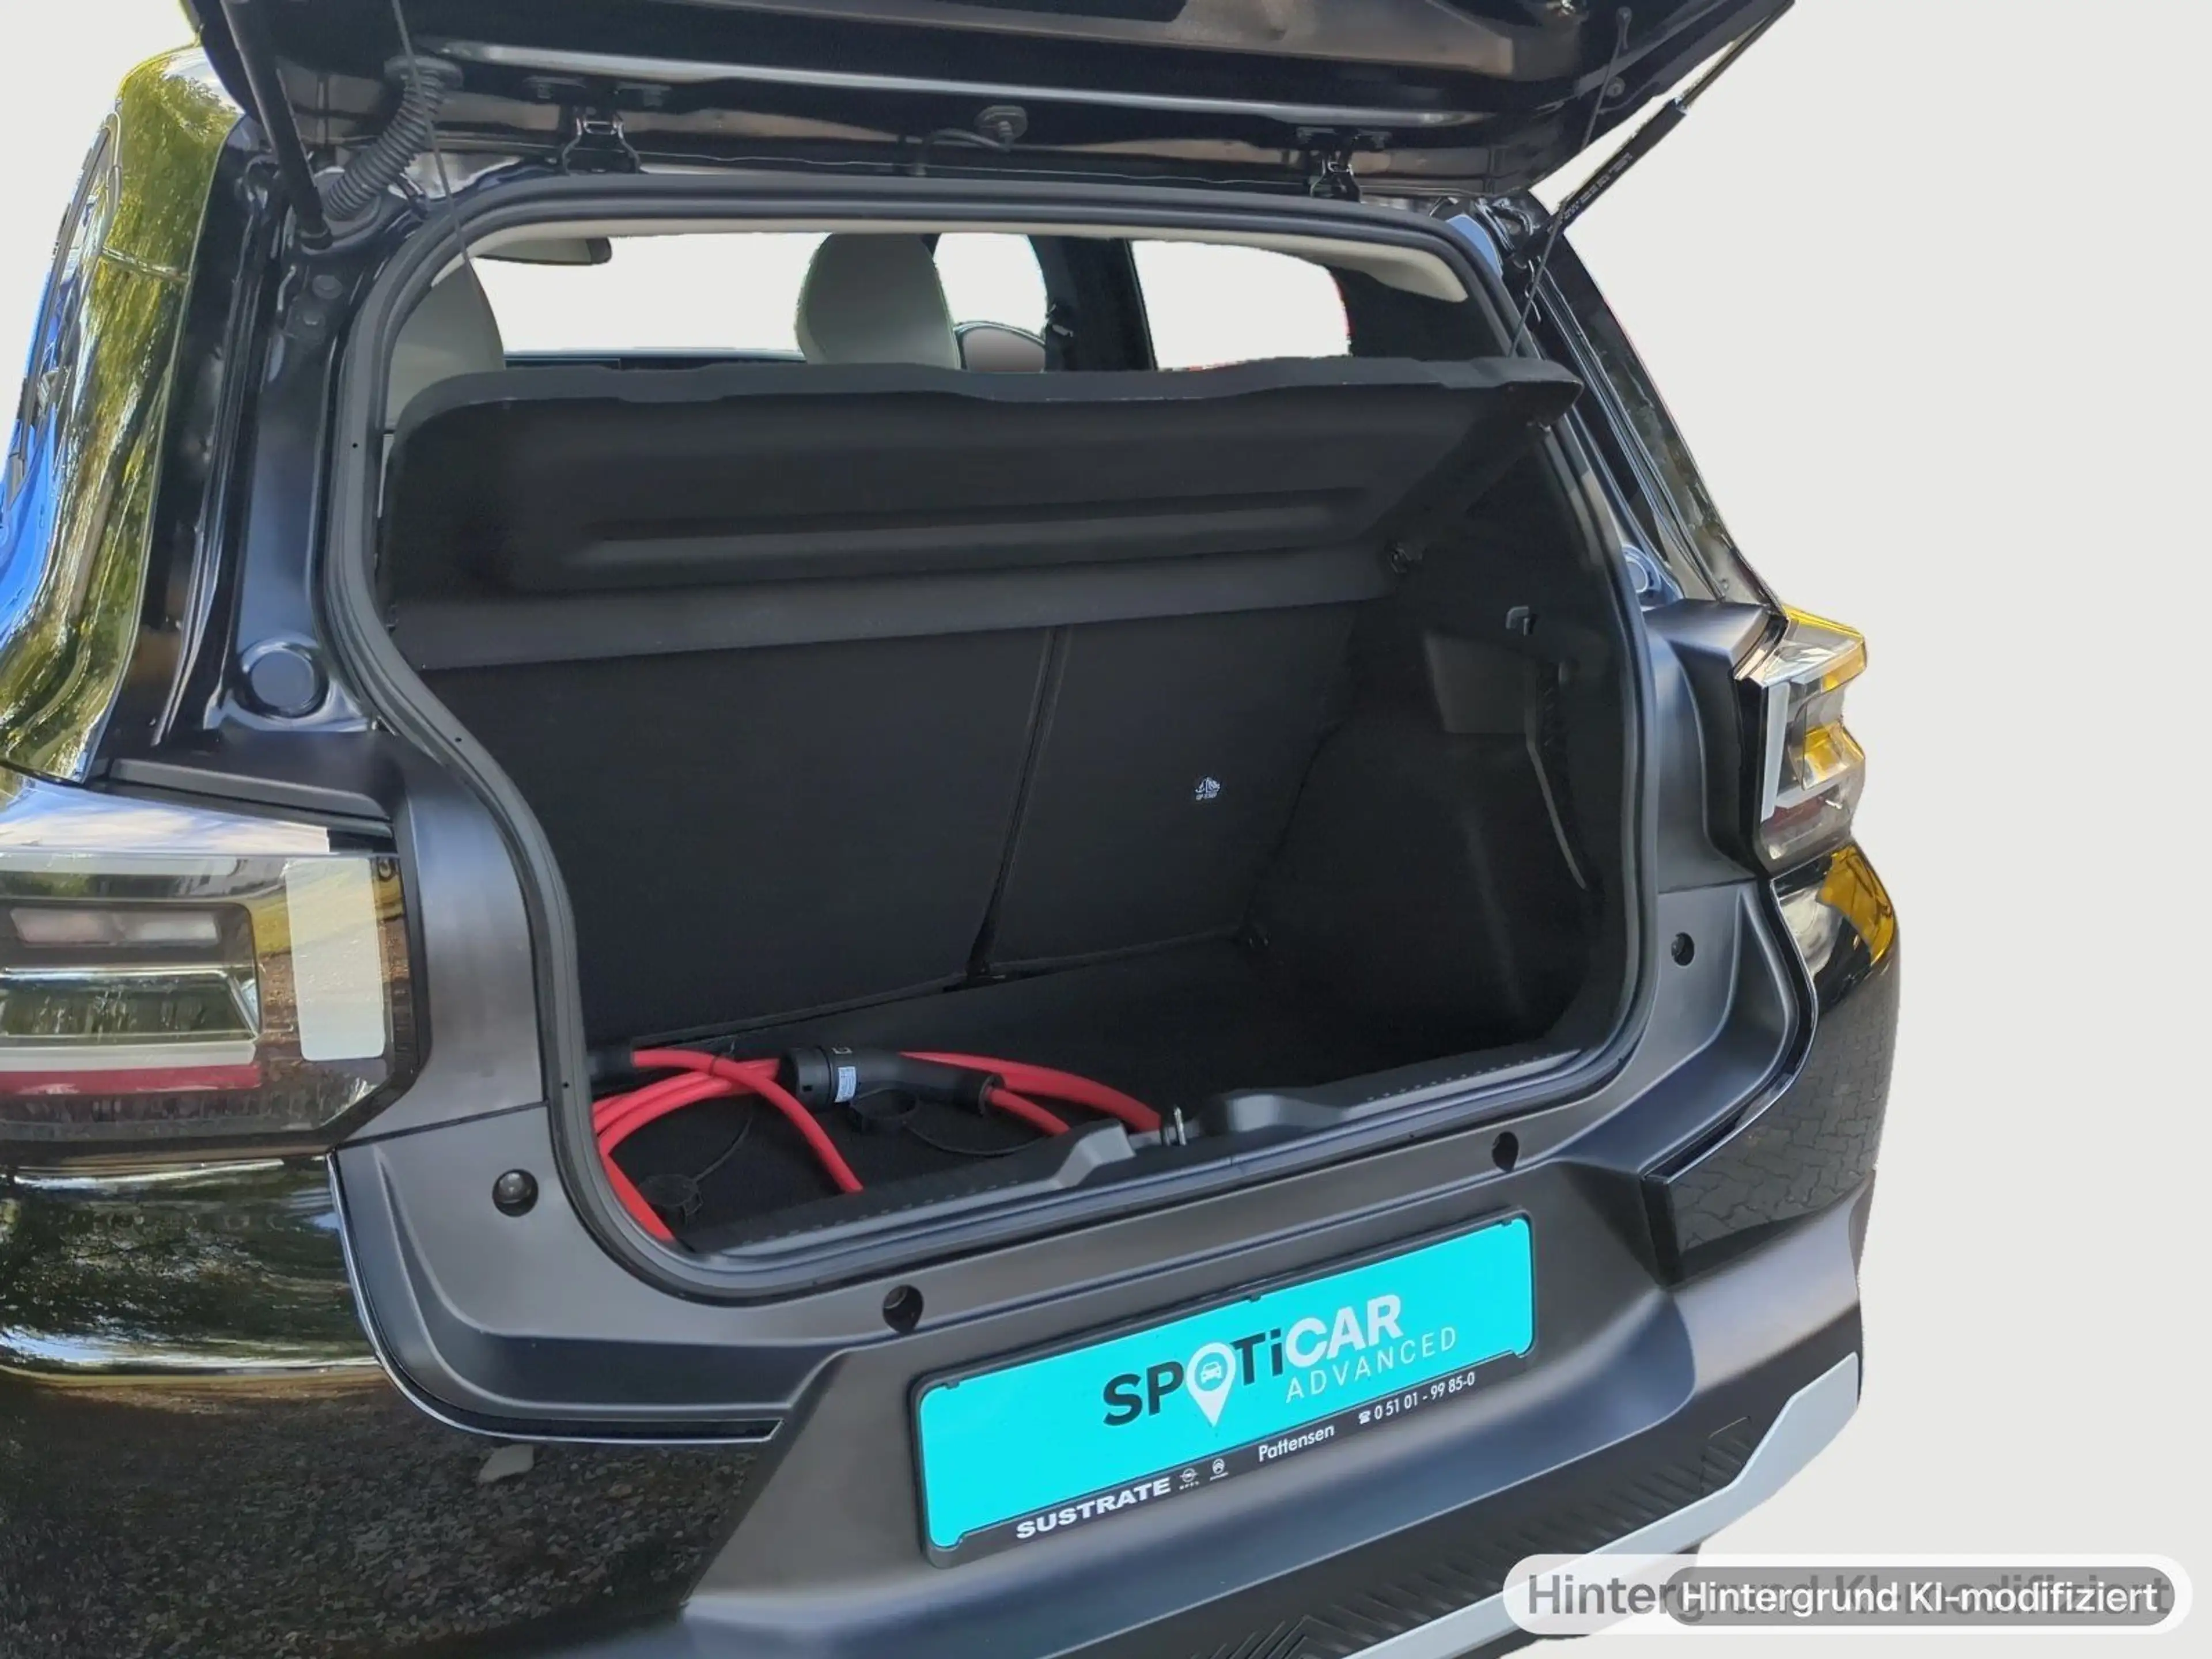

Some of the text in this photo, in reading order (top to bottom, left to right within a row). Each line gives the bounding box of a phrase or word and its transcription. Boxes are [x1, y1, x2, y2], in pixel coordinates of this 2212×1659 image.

[1285, 1327, 1456, 1403] ADVANCED
[1374, 1405, 1382, 1420] 0
[1385, 1399, 1400, 1416] 51
[1404, 1392, 1418, 1409] 01
[1430, 1382, 1445, 1400] 99
[1448, 1371, 1475, 1393] 85-0
[1259, 1425, 1335, 1462] Pattensen
[1017, 1477, 1171, 1539] SUSTRATE
